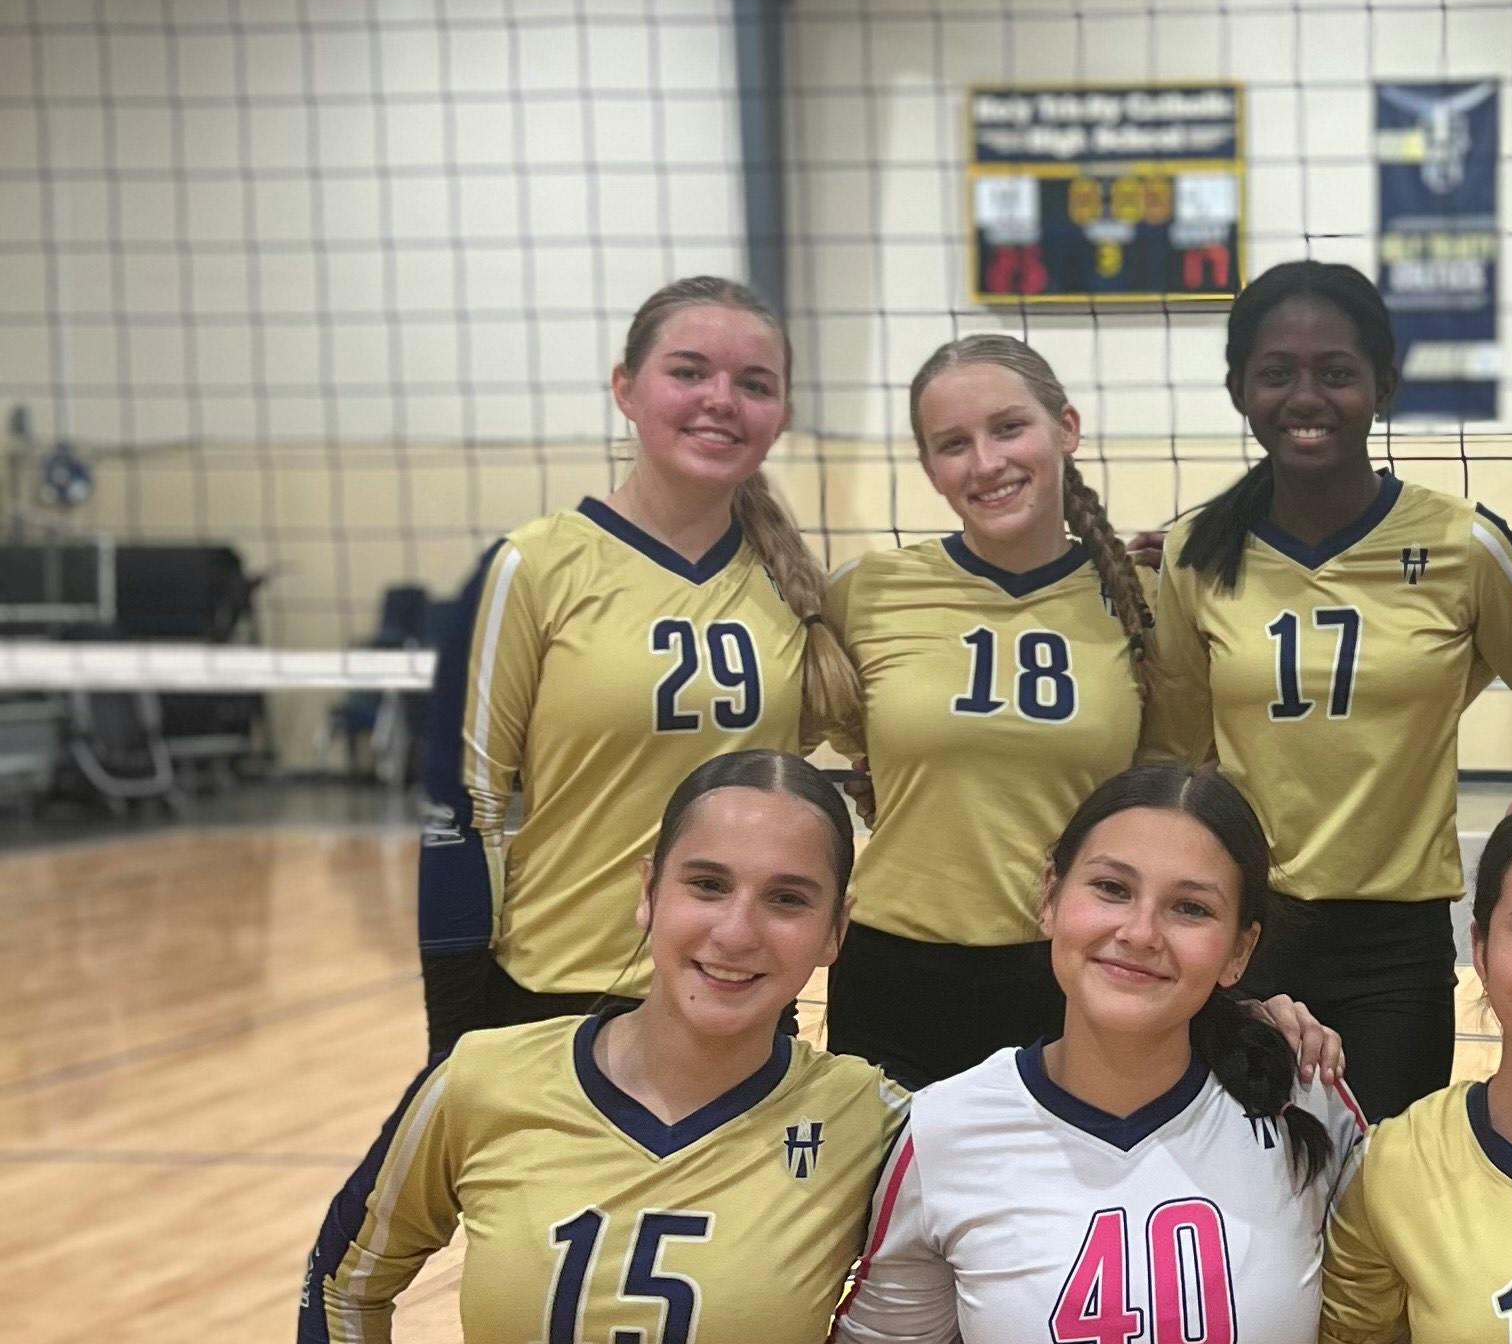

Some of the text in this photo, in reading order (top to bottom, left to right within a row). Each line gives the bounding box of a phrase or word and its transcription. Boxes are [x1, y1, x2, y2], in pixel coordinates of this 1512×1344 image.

[649, 617, 763, 735] 29
[950, 626, 1079, 724] 18
[1266, 605, 1362, 721] 17
